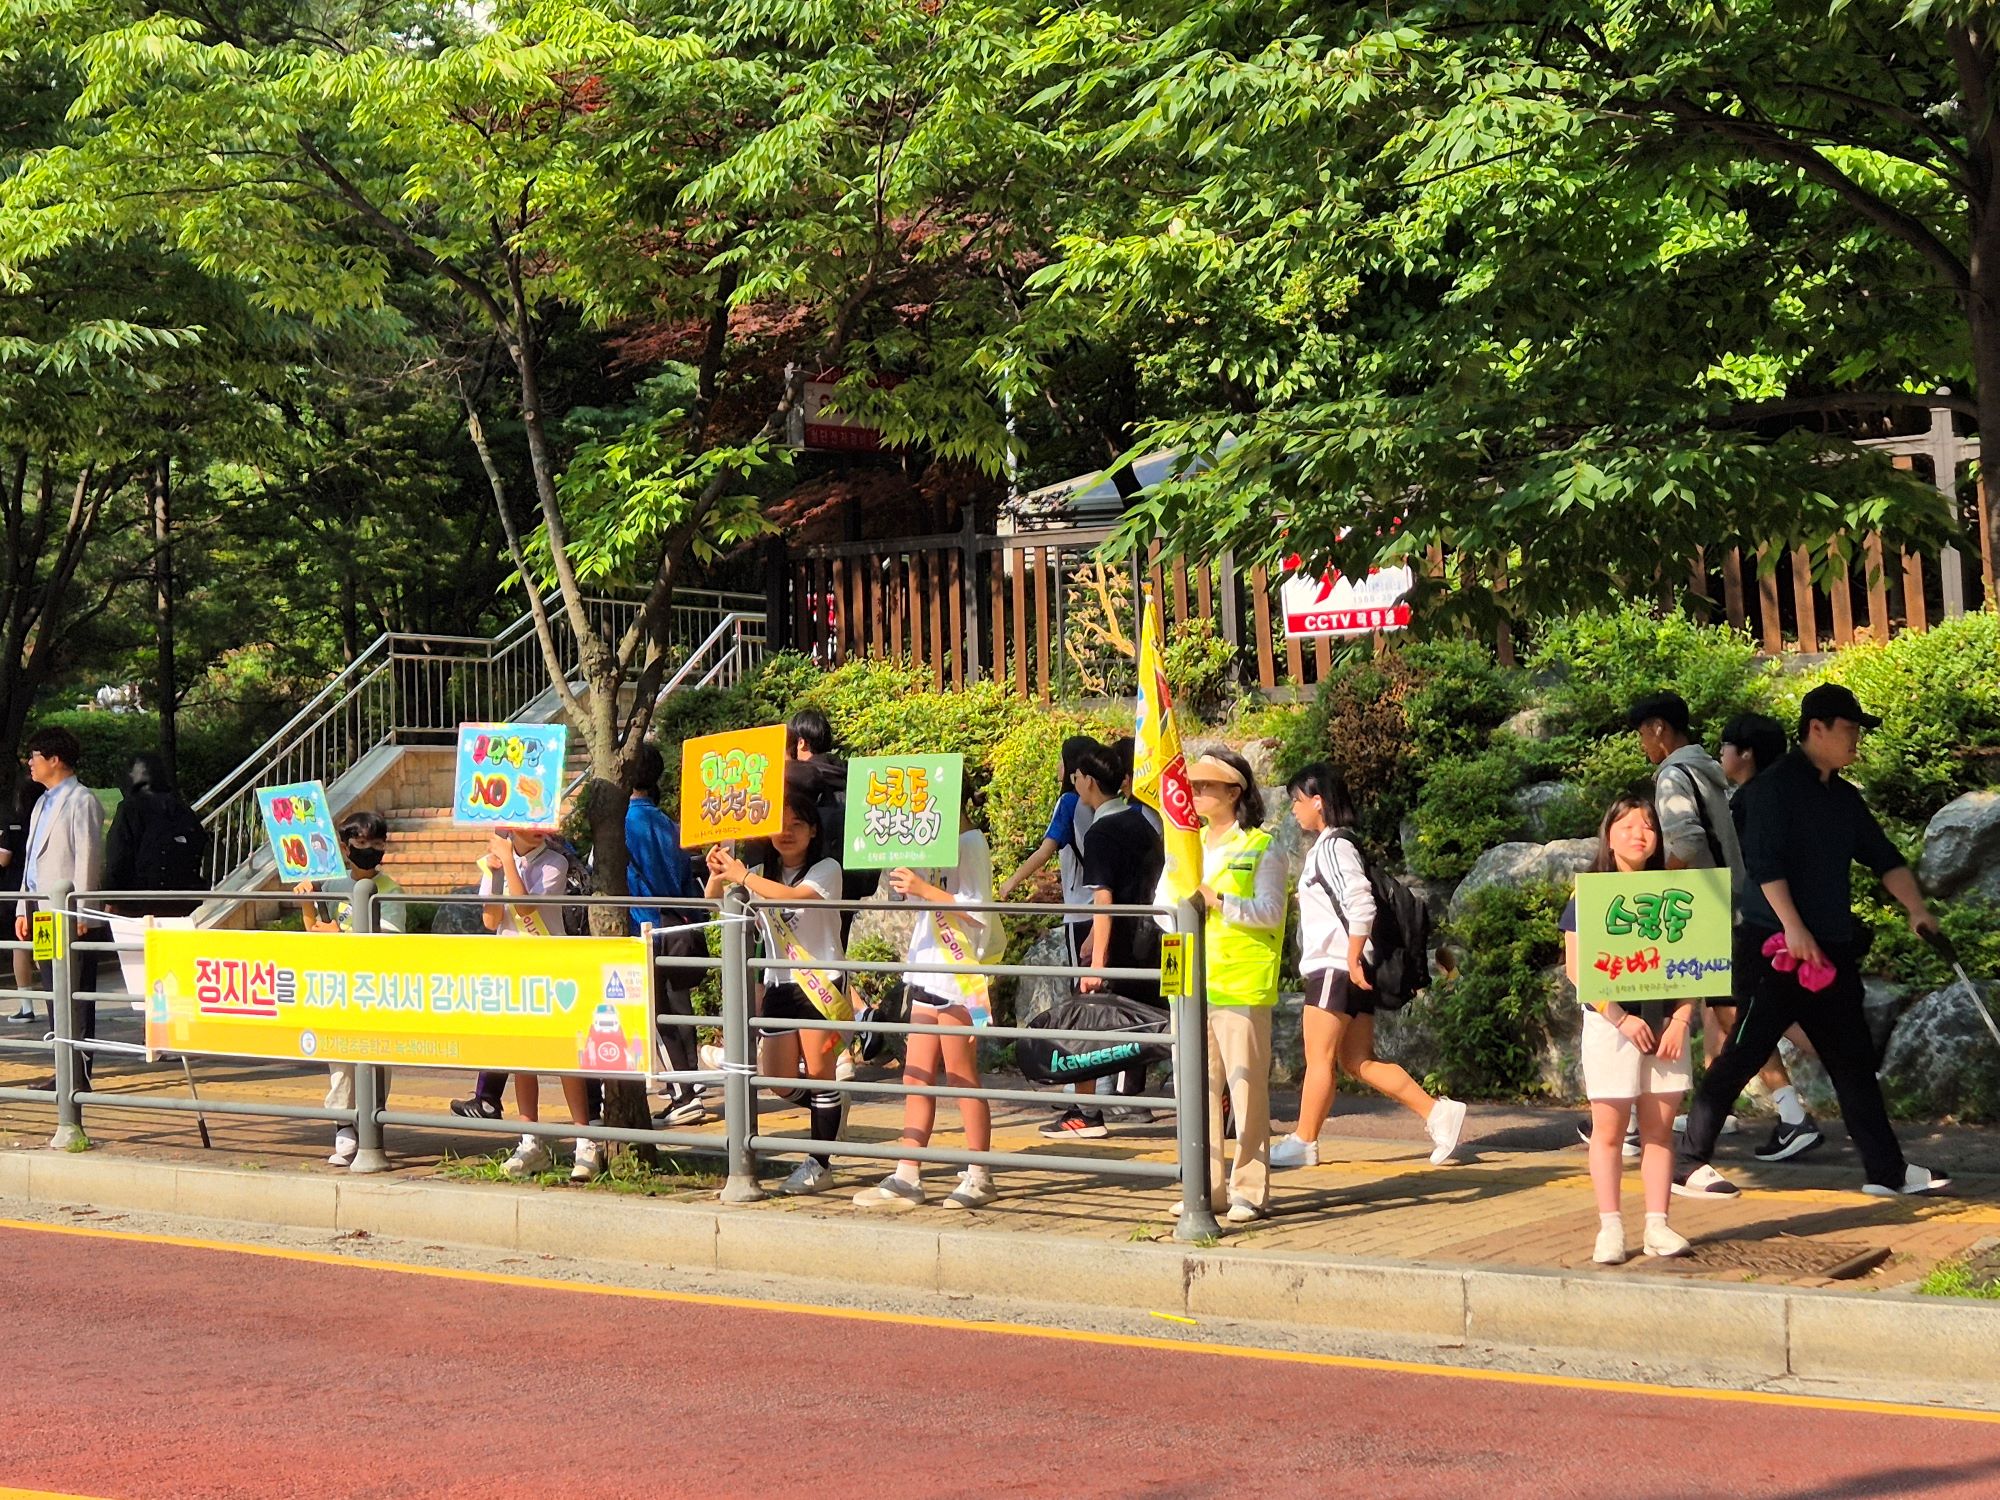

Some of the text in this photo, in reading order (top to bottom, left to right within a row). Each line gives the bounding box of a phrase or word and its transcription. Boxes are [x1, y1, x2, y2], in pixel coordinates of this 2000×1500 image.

[1305, 613, 1351, 630] CCTV
[470, 775, 508, 808] NO
[700, 786, 771, 825] 천천히
[863, 795, 942, 846] 천천히
[281, 838, 308, 868] NO
[1605, 888, 1695, 943] 스쿨존
[196, 959, 555, 1014] 정지선을 지켜 주셔서 감사합니다
[601, 1046, 617, 1058] 30
